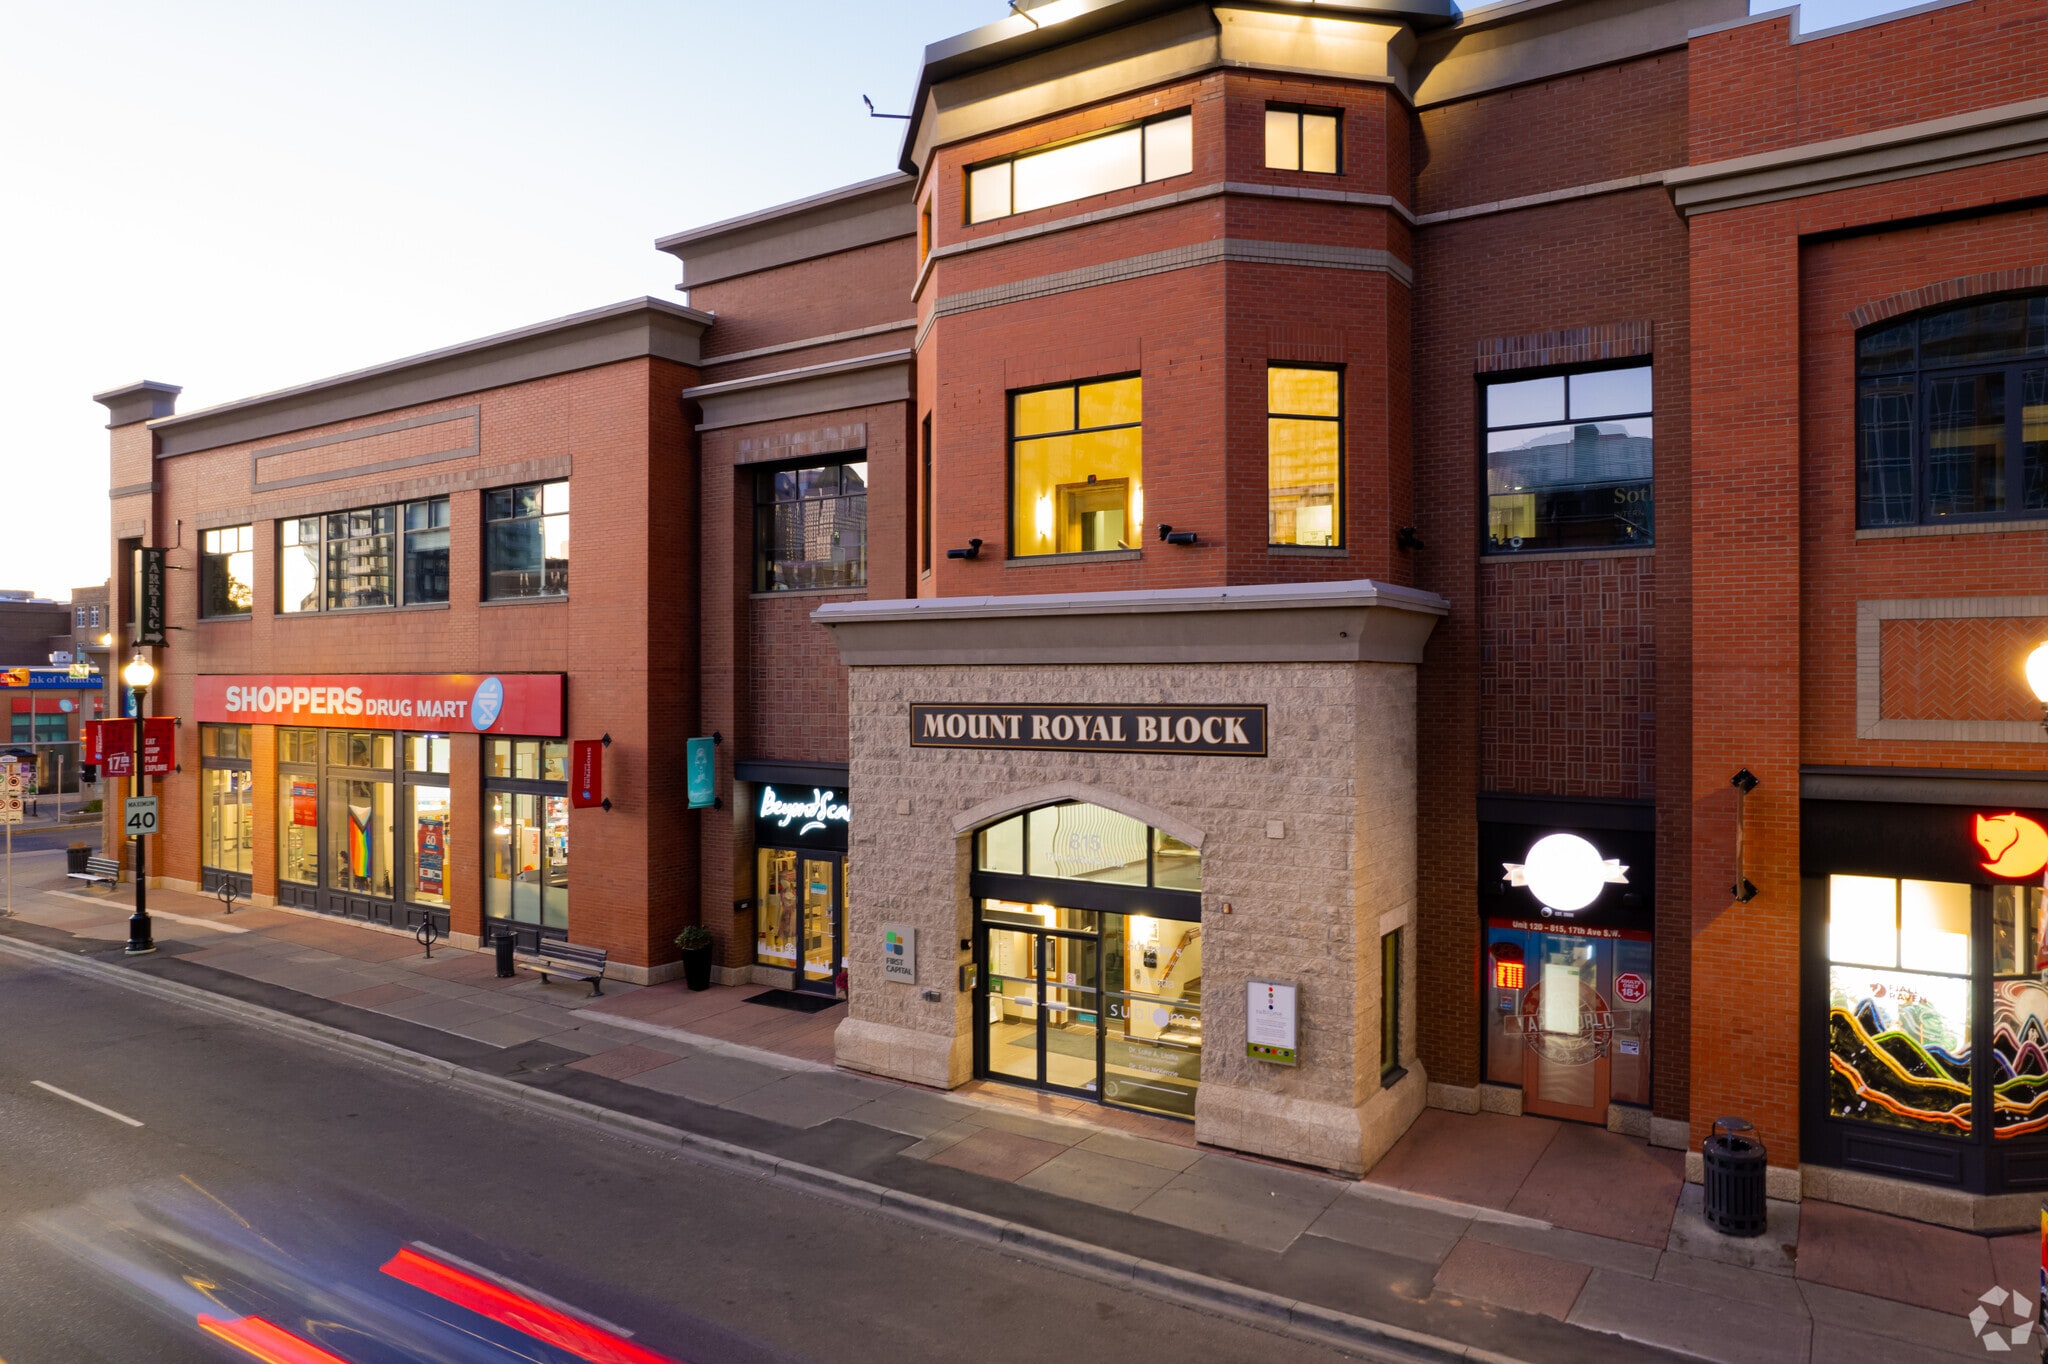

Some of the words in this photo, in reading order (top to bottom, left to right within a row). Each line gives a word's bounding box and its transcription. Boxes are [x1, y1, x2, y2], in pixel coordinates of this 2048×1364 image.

[148, 551, 160, 629] PARKING
[46, 675, 58, 684] of
[225, 686, 363, 716] SHOPPERS
[366, 698, 412, 717] DRUG
[417, 699, 468, 718] MART
[922, 713, 1023, 740] MOUNT
[1031, 714, 1127, 742] ROYAL
[1136, 716, 1250, 744] BLOCK
[107, 756, 121, 770] 17
[145, 764, 168, 772] EXPLORE
[761, 786, 820, 827] Beyond
[817, 791, 851, 822] Sca
[128, 811, 155, 829] 40
[1070, 832, 1101, 851] 815
[1512, 920, 1527, 929] Unit
[1529, 922, 1542, 931] 120
[1550, 924, 1566, 934] 815,
[1568, 926, 1585, 935] 17th
[1587, 927, 1601, 936] Ave
[1603, 929, 1621, 938] S.W.
[886, 957, 904, 966] FIRST
[886, 966, 912, 976] CAPITAL
[1622, 988, 1640, 997] 18+
